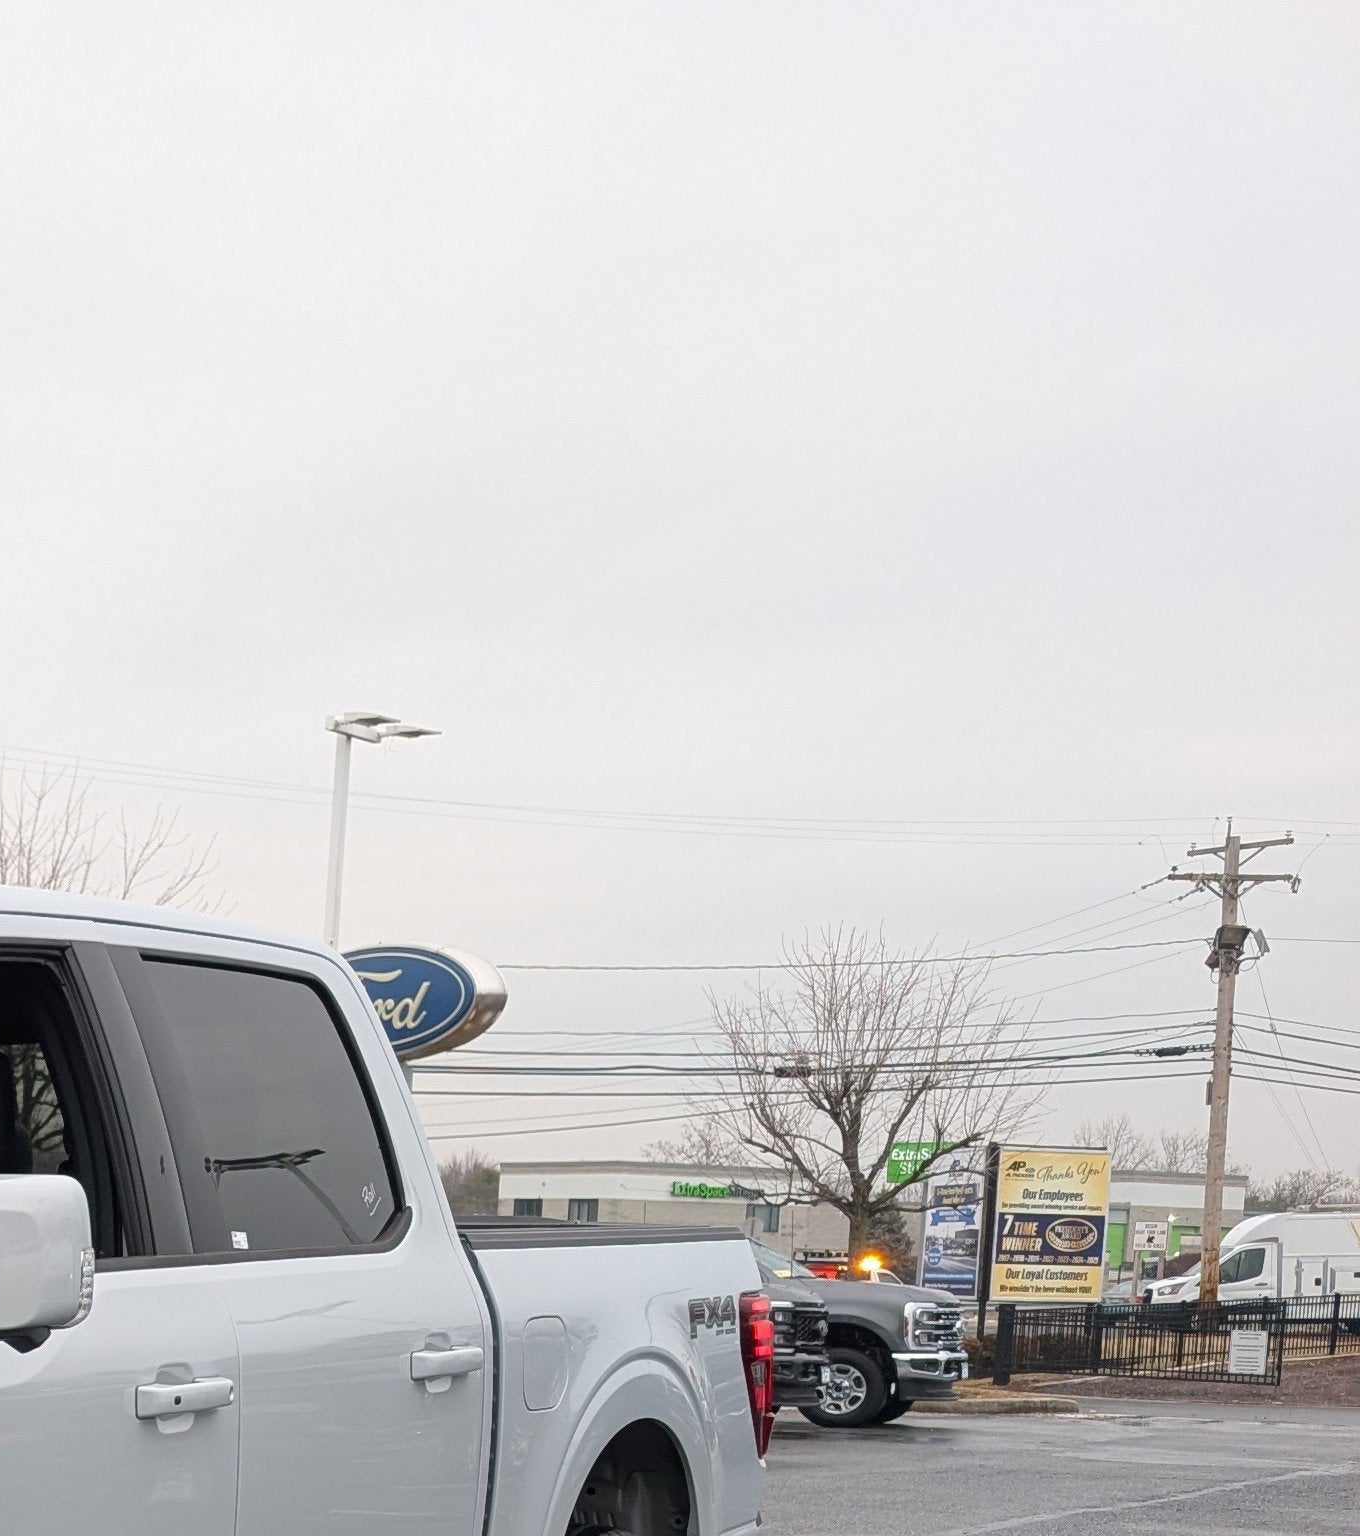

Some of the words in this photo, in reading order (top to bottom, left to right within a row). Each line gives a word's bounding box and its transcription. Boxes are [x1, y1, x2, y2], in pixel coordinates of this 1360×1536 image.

[1006, 1160, 1027, 1172] AP
[1037, 1165, 1074, 1183] Thanks
[1077, 1161, 1106, 1185] You!
[1022, 1187, 1038, 1200] Our
[1039, 1189, 1084, 1203] Employees
[1002, 1214, 1014, 1236] 7
[1014, 1221, 1039, 1236] TIME
[1001, 1237, 1043, 1252] WINNER
[1005, 1268, 1021, 1280] Our
[1021, 1268, 1044, 1282] Loyal
[1044, 1269, 1089, 1281] Customers
[688, 1295, 736, 1339] FX4
